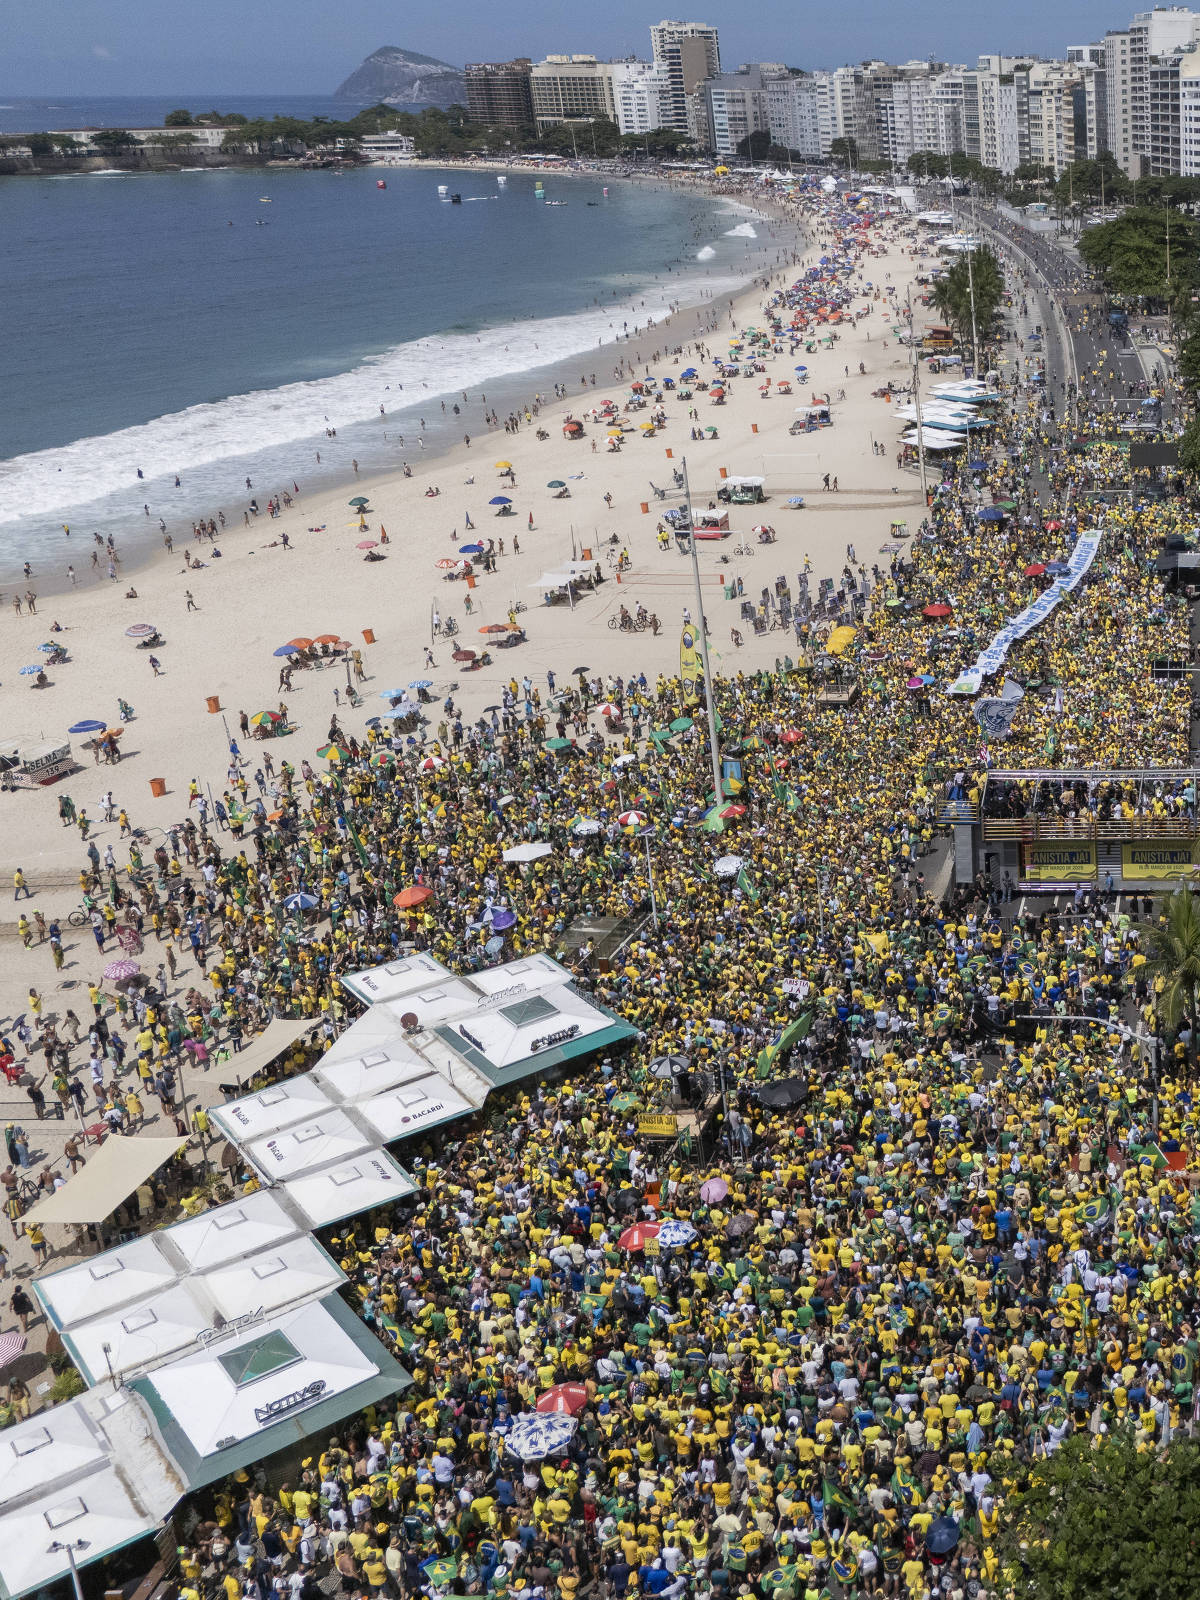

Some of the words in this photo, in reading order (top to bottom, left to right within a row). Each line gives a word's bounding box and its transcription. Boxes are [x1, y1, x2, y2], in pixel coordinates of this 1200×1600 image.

[30, 753, 58, 771] SELMA
[46, 766, 60, 776] 139
[1033, 852, 1071, 863] ANISTIA
[1134, 851, 1171, 863] ANISTIA
